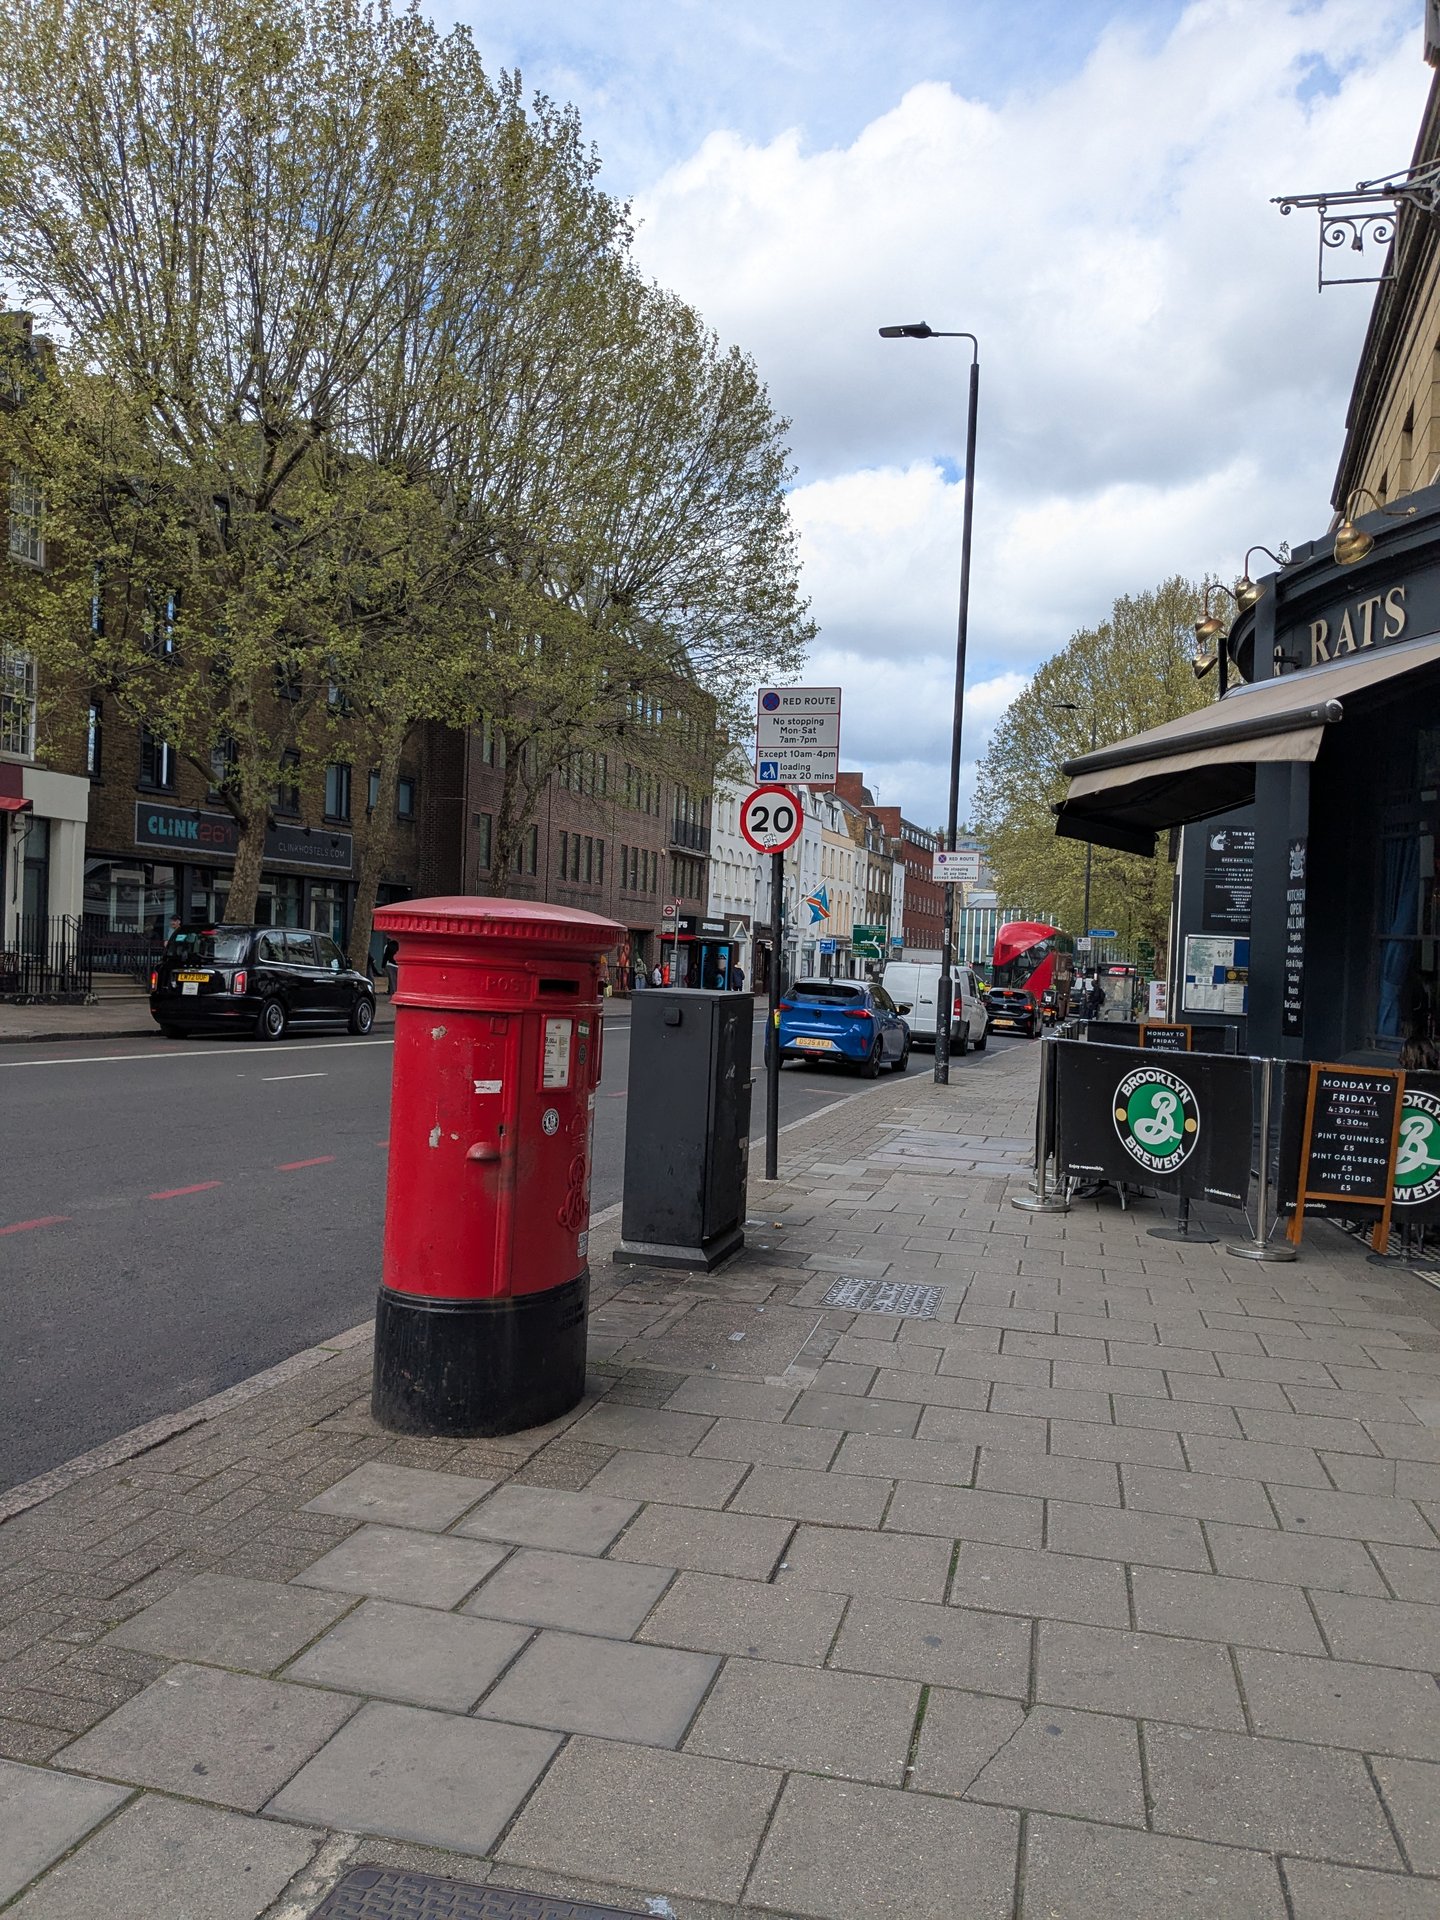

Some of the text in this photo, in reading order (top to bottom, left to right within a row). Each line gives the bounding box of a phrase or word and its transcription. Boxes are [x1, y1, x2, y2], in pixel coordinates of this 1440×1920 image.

[1309, 584, 1406, 667] RATS
[782, 697, 836, 706] RED ROUTE
[772, 717, 825, 726] No stopping
[780, 726, 817, 734] Mon-Sat
[779, 736, 818, 744] 7am-7pm
[758, 750, 836, 759] Except 10am-4pm
[780, 763, 811, 772] loading
[814, 772, 834, 780] mins
[751, 805, 794, 834] 20
[1286, 888, 1306, 902] KITCHEN
[1289, 902, 1303, 915] OPEN
[1286, 916, 1306, 929] ALL DAY
[485, 975, 530, 993] POST
[1121, 1071, 1191, 1104] BROOKLYN
[1322, 1079, 1391, 1092] MONDAY TO
[1332, 1093, 1377, 1105] FRIDAY,
[1328, 1106, 1360, 1115] 4:30PM
[1336, 1118, 1369, 1127] 6:30PM
[1317, 1132, 1385, 1144] PINT GUINNESS
[1125, 1135, 1185, 1169] BREWERY
[1343, 1144, 1355, 1152] £5
[1312, 1152, 1386, 1165] PINT CARLSBERG
[1341, 1164, 1353, 1172] £5
[1322, 1172, 1372, 1183] PINT CIDER
